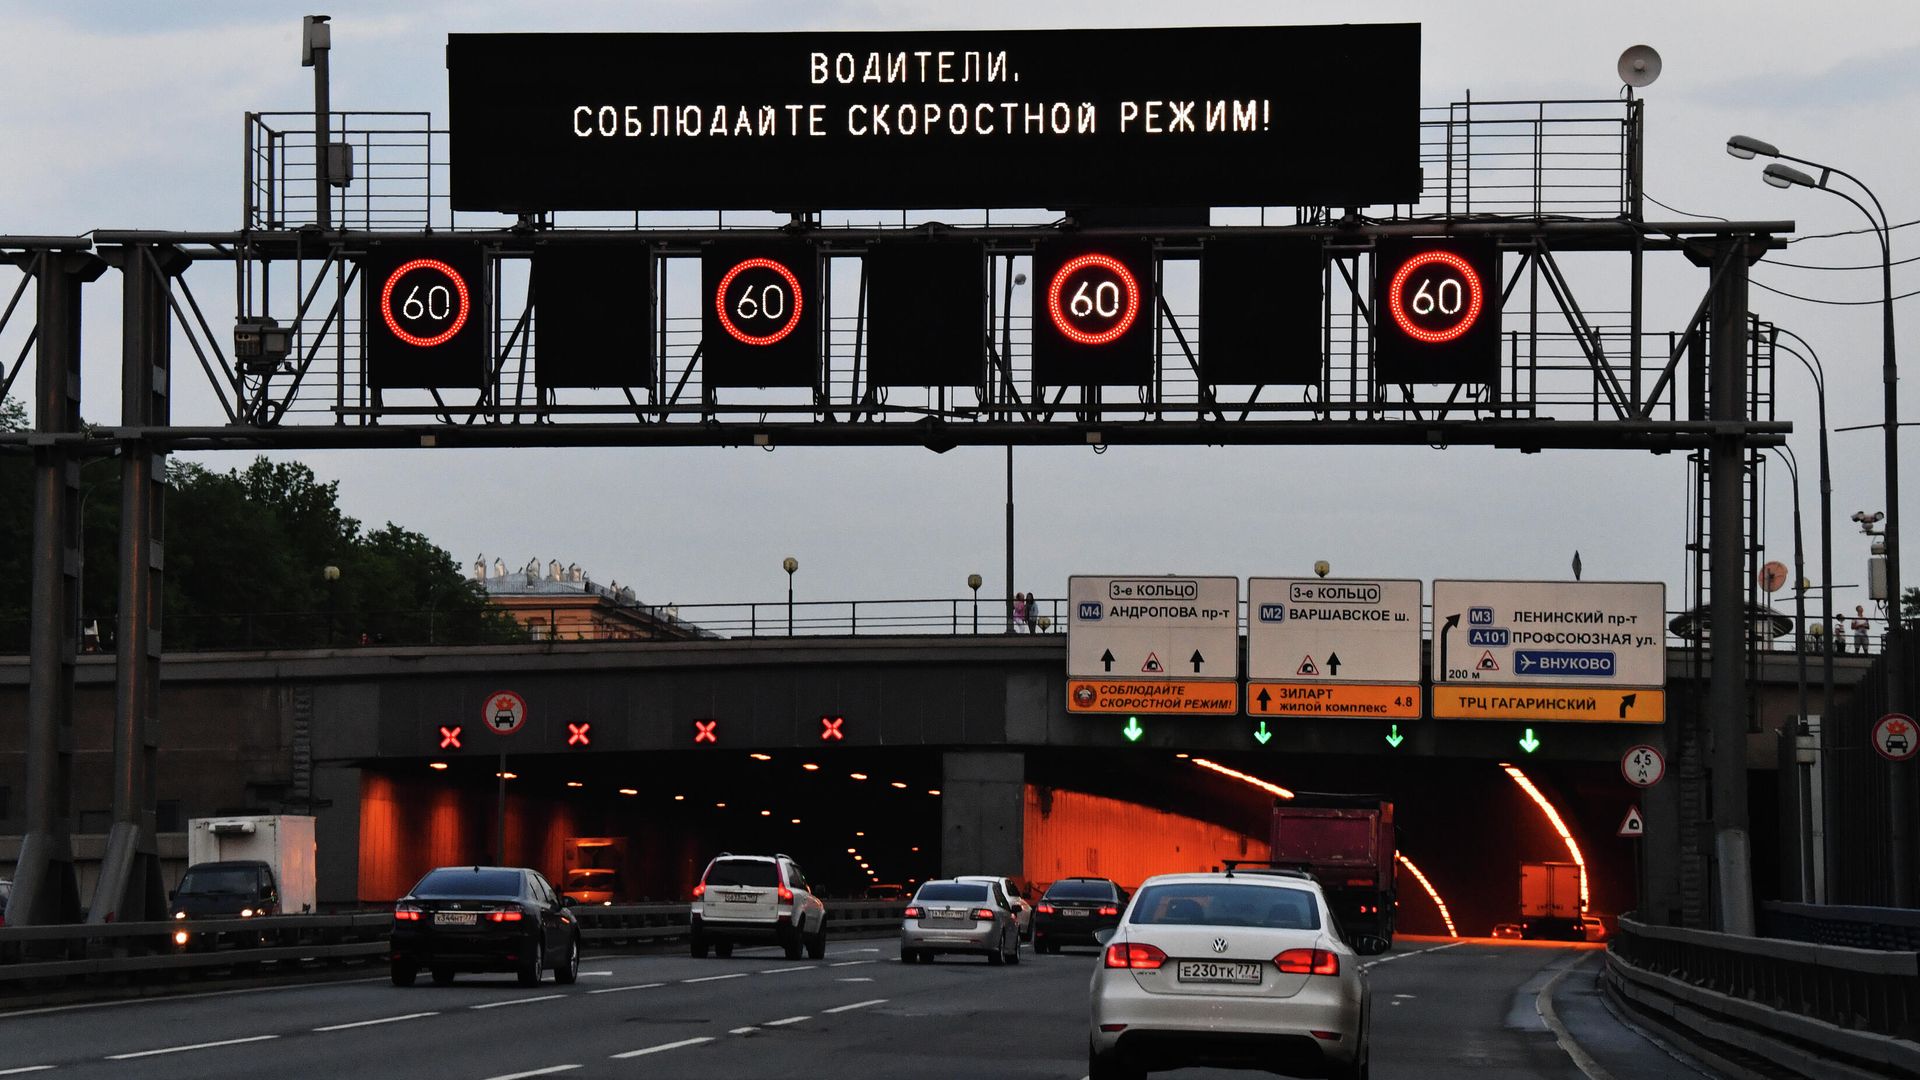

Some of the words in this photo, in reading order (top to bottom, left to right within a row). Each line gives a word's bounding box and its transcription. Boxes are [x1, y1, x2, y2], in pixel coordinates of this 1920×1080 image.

[573, 104, 827, 137] СОБЛЮДАЙТЕ
[848, 101, 1096, 136] СКОРОСТНОЙ
[1120, 99, 1270, 133] РЕЖИМ!
[403, 285, 450, 320] 60
[737, 284, 784, 319] 60
[1070, 280, 1119, 317] 60
[1412, 278, 1462, 314] 60
[1112, 584, 1133, 597] 3-е
[1136, 584, 1195, 598] КОЛЬЦО
[1293, 586, 1314, 599] 3-е
[1317, 587, 1378, 602] КОЛЬЦО
[1081, 605, 1100, 617] М4
[1109, 606, 1198, 619] АНДРОПОВА
[1201, 609, 1230, 621] пр-т
[1262, 607, 1282, 620] М2
[1289, 608, 1390, 622] ВАРШАВСКОЕ
[1394, 612, 1410, 622] ш.
[1471, 610, 1492, 623] М3
[1512, 610, 1604, 624] ЛЕНИНСКИЙ
[1608, 614, 1638, 627] пр-т
[1473, 631, 1507, 643] А101
[1512, 631, 1632, 645] ПРОФСОЮЗНАЯ
[1635, 636, 1657, 648] ул.
[1539, 657, 1611, 670] ВНУКОВО
[1448, 669, 1469, 679] 200
[1100, 684, 1185, 697] СОБЛЮДАЙТЕ
[1279, 688, 1334, 700] ЗИЛАРТ
[1100, 697, 1182, 709] СКОРОСТНОЙ
[1184, 699, 1233, 709] РЕЖИМ!
[1279, 701, 1322, 712] жилой
[1325, 703, 1388, 713] комплекс
[1458, 696, 1487, 710] ТРЦ
[1491, 696, 1597, 711] ГАГАРИНСКИЙ
